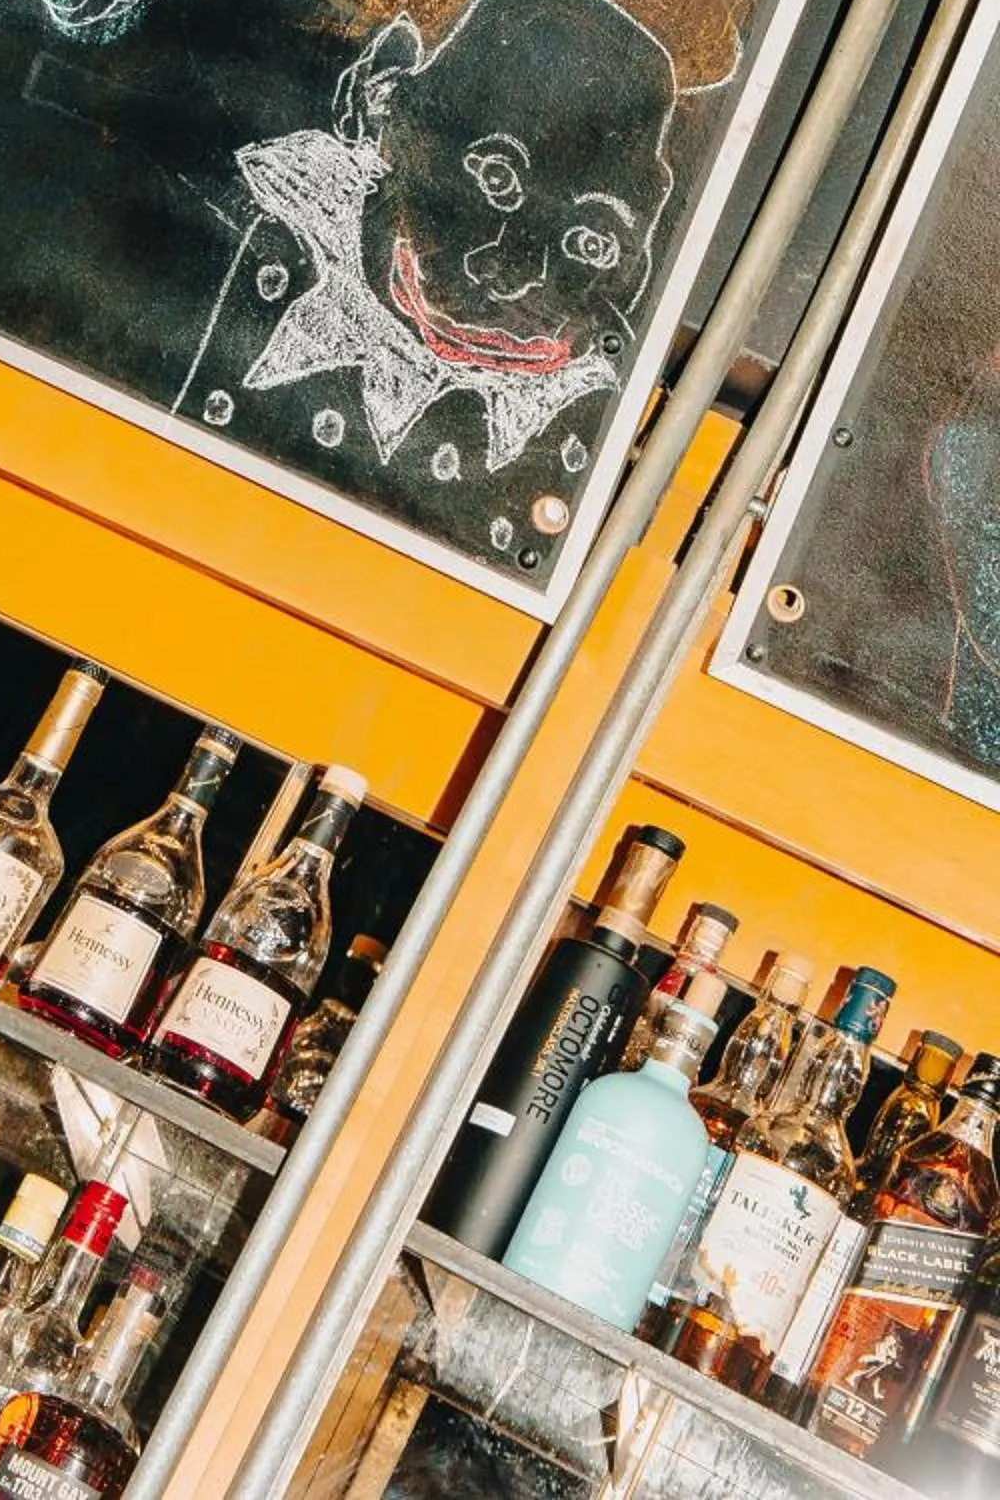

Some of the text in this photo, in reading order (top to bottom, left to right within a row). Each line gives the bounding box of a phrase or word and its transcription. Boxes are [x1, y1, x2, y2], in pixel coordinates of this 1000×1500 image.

[67, 925, 135, 970] Hennessy
[193, 980, 265, 1032] Hennessy
[525, 994, 600, 1125] OCTOMORE
[867, 1244, 918, 1264] BLACK
[923, 1255, 973, 1273] LABEL
[844, 1400, 866, 1423] 12
[7, 1452, 89, 1500] MOUNT GAY
